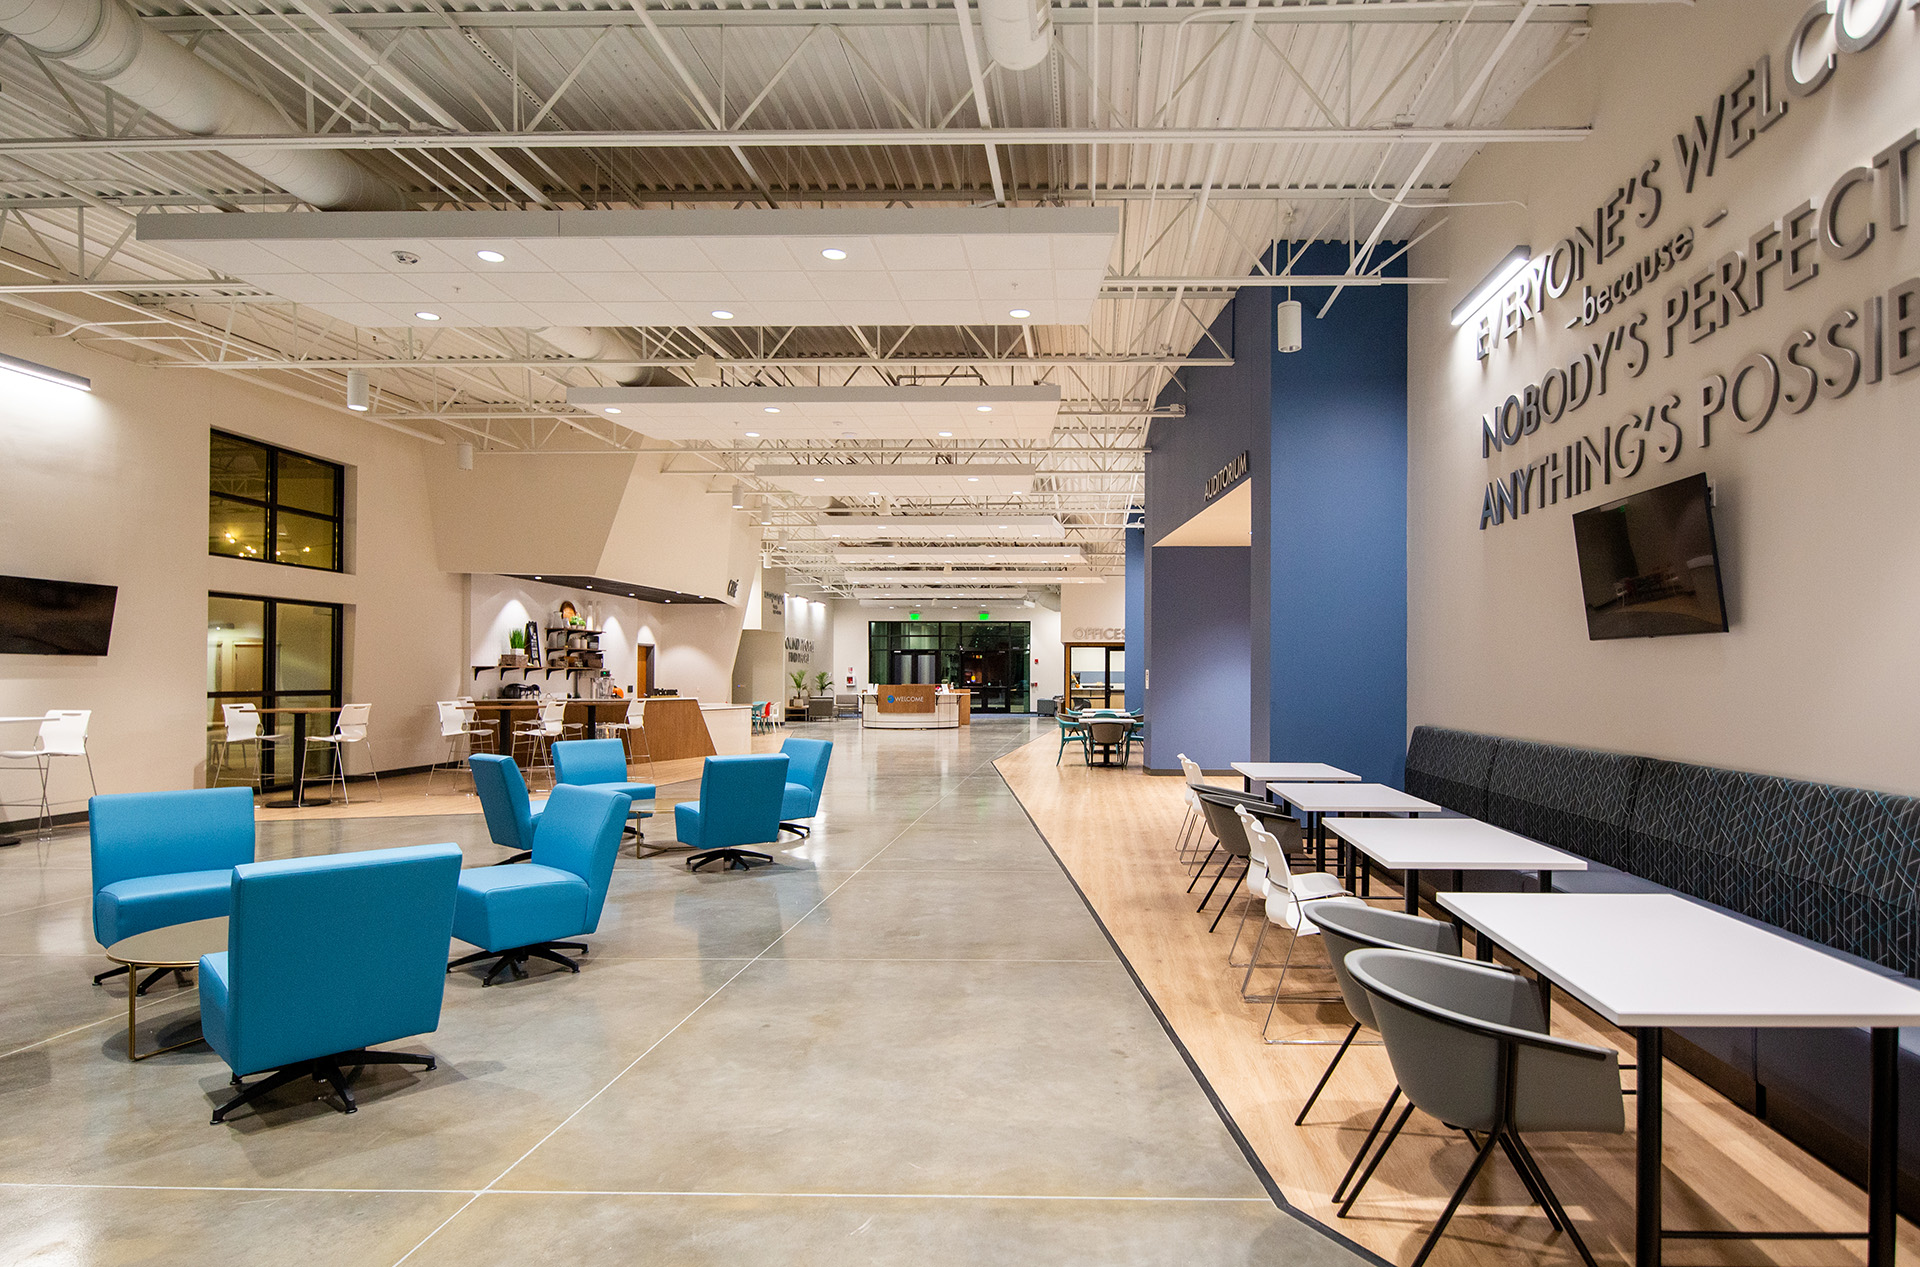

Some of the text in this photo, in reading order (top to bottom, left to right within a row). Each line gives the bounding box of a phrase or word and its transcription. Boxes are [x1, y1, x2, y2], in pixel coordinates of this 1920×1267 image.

[1477, 0, 1920, 361] EVERYONE'S WELCO
[1482, 127, 1920, 458] NOBODY'S PERFECT
[1203, 450, 1249, 501] AUDITORIUM
[1480, 395, 1682, 530] ANYTHING'S
